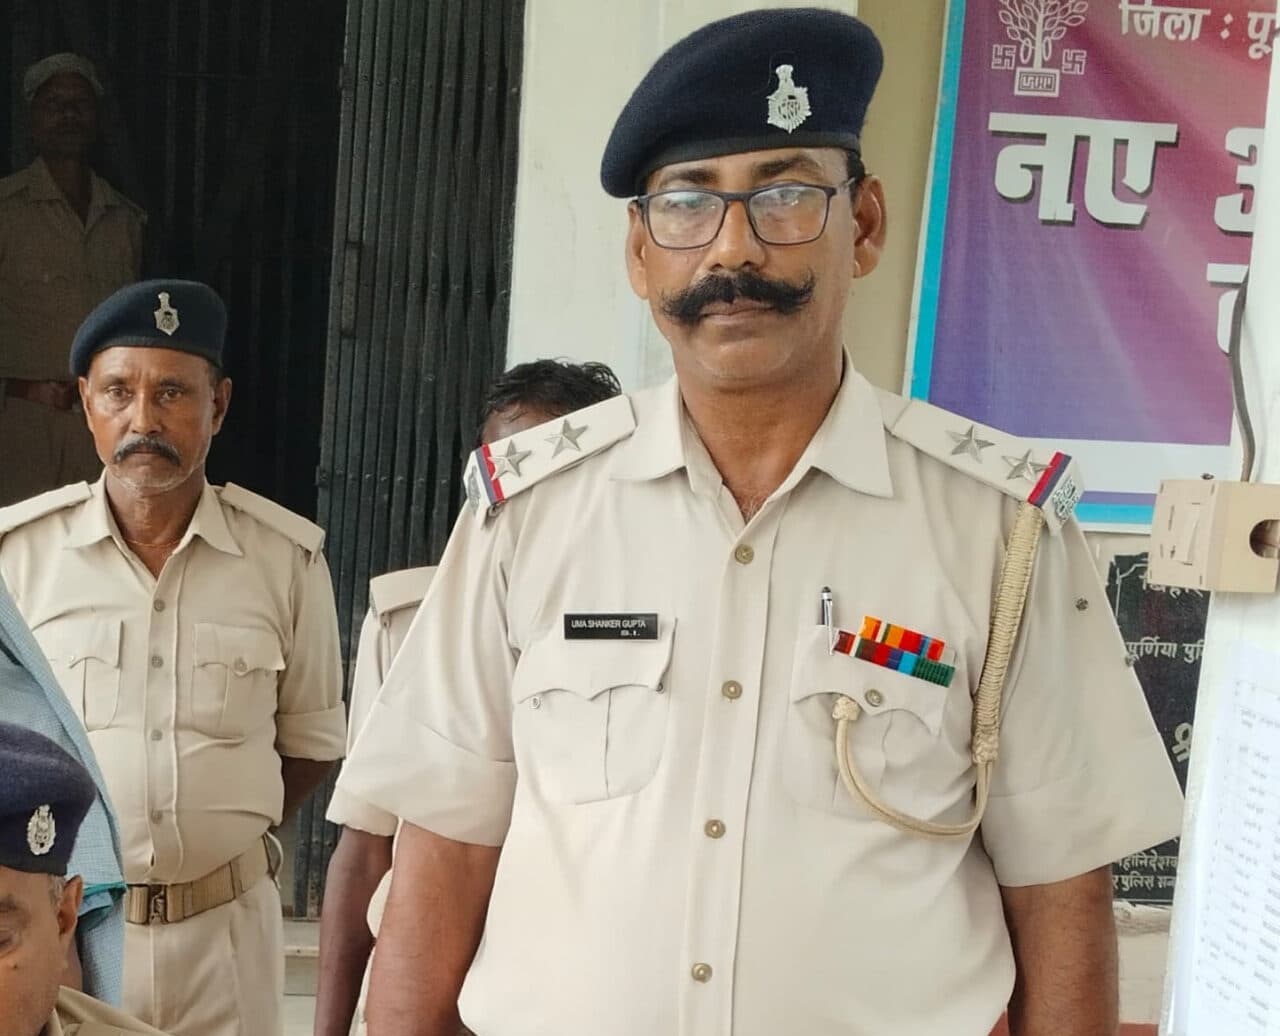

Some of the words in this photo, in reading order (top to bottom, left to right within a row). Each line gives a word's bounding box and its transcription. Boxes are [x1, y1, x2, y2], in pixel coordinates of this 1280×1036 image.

[1119, 0, 1211, 41] जिला
[988, 112, 1178, 226] नए
[621, 619, 646, 629] GUPTA
